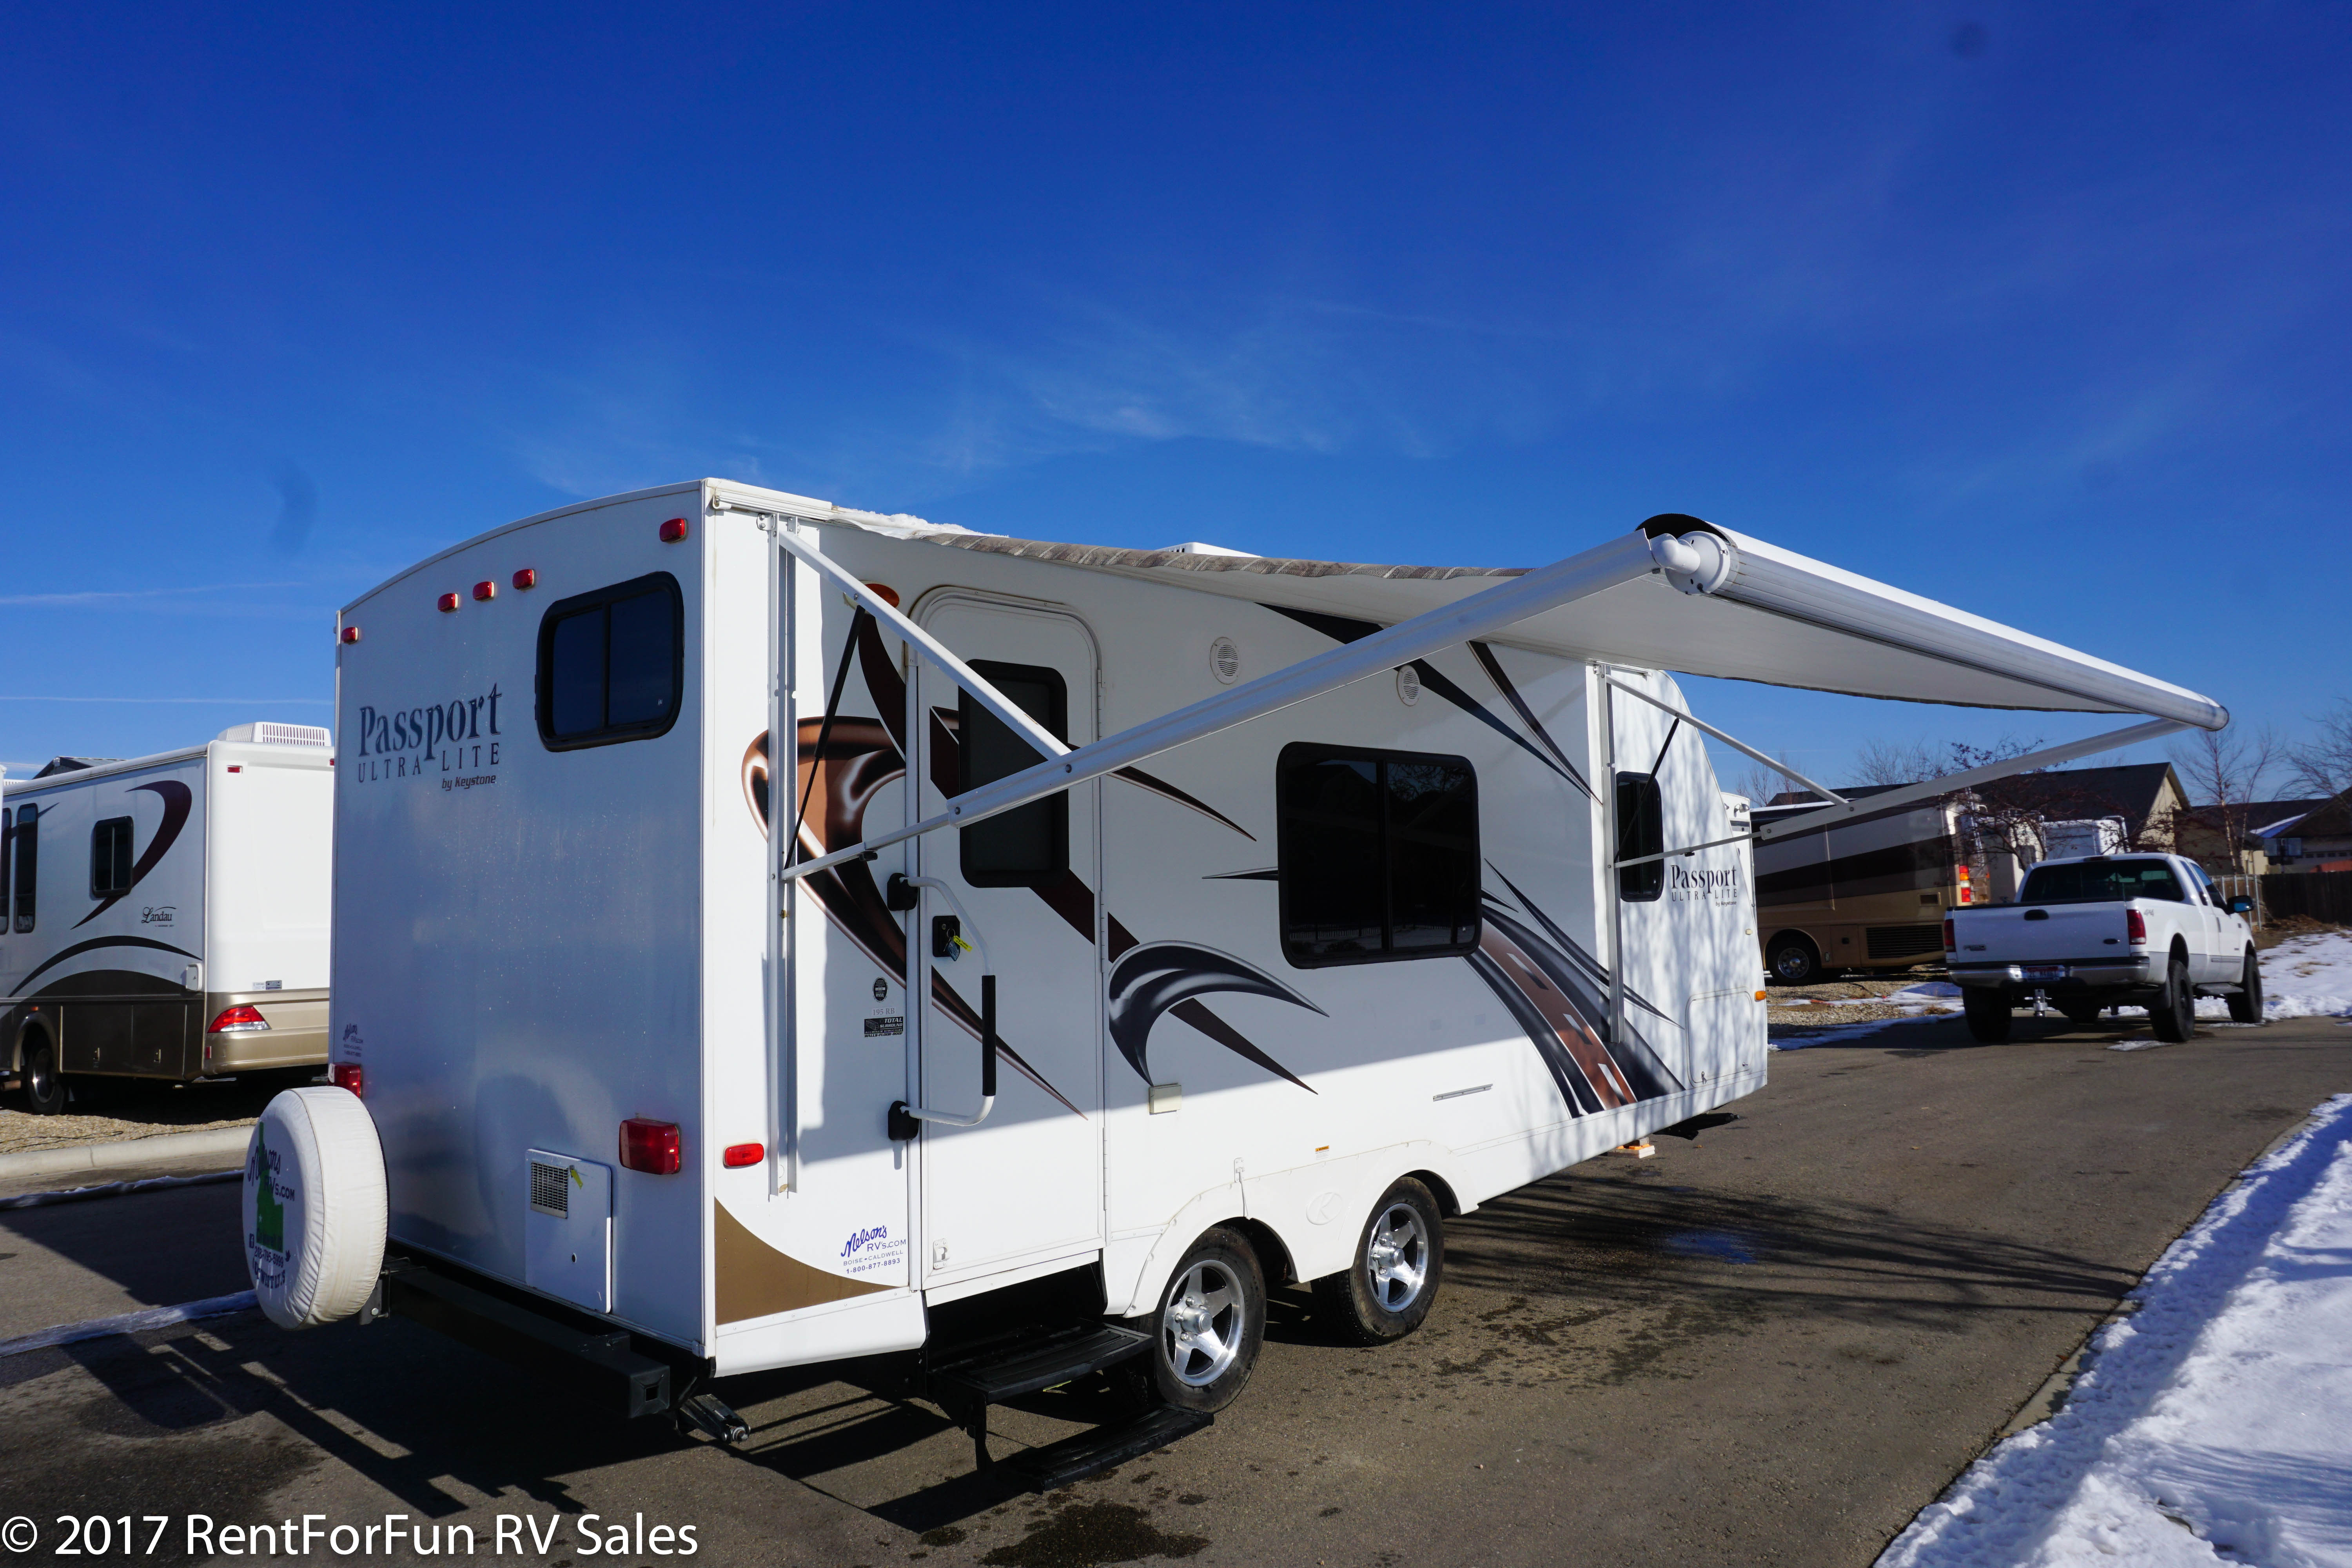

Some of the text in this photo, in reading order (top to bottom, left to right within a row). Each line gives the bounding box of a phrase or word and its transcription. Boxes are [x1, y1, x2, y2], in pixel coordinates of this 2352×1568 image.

[359, 682, 502, 761] Passport
[358, 742, 500, 783] ULTRA LITE
[442, 775, 496, 791] by Keystone
[1670, 865, 1737, 894] Passport
[1671, 889, 1737, 902] ULTRA LITE
[141, 907, 172, 923] Landau
[840, 1225, 887, 1258] Nelson's
[846, 1258, 900, 1274] 1-800-877-8893
